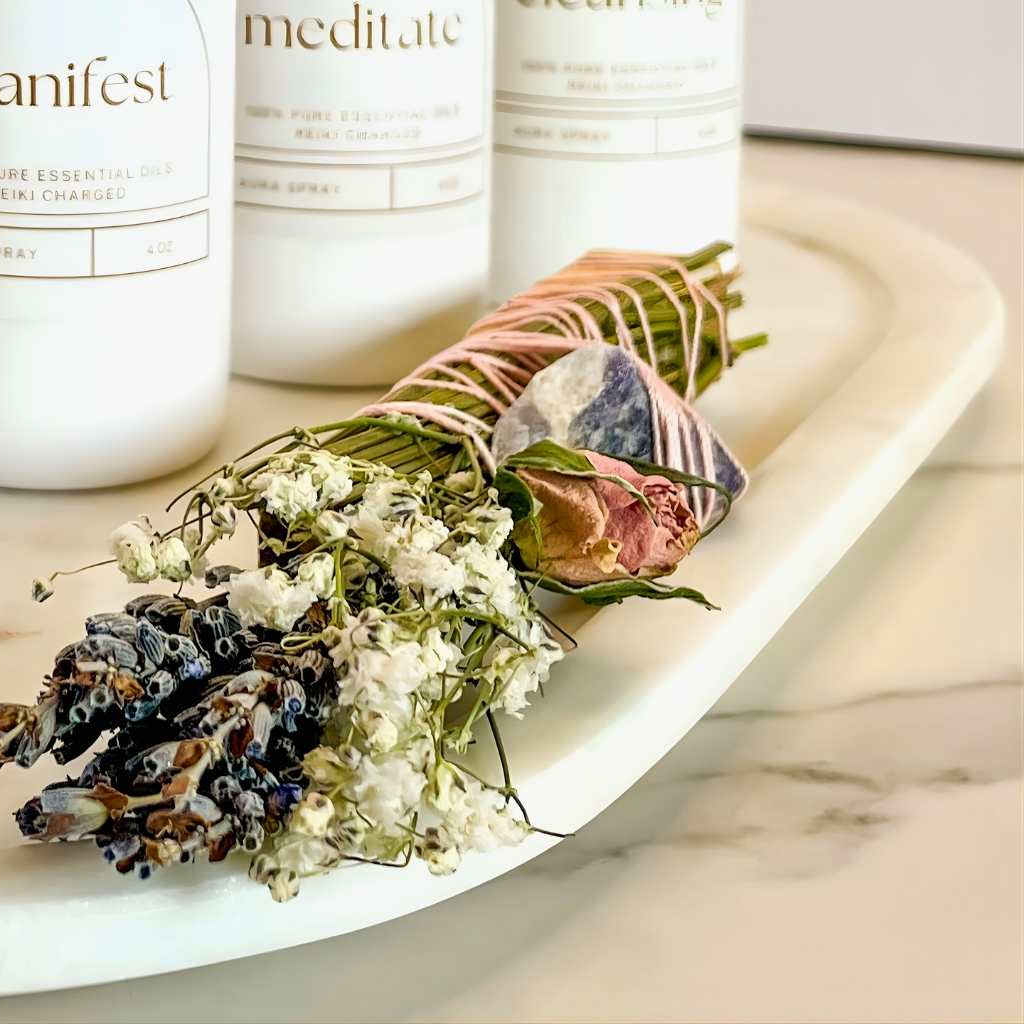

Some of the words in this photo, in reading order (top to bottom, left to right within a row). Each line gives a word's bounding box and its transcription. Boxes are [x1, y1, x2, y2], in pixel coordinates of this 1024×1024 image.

[245, 0, 461, 50] meditate
[37, 167, 134, 182] ESSENTIAL
[42, 187, 126, 202] CHARGED
